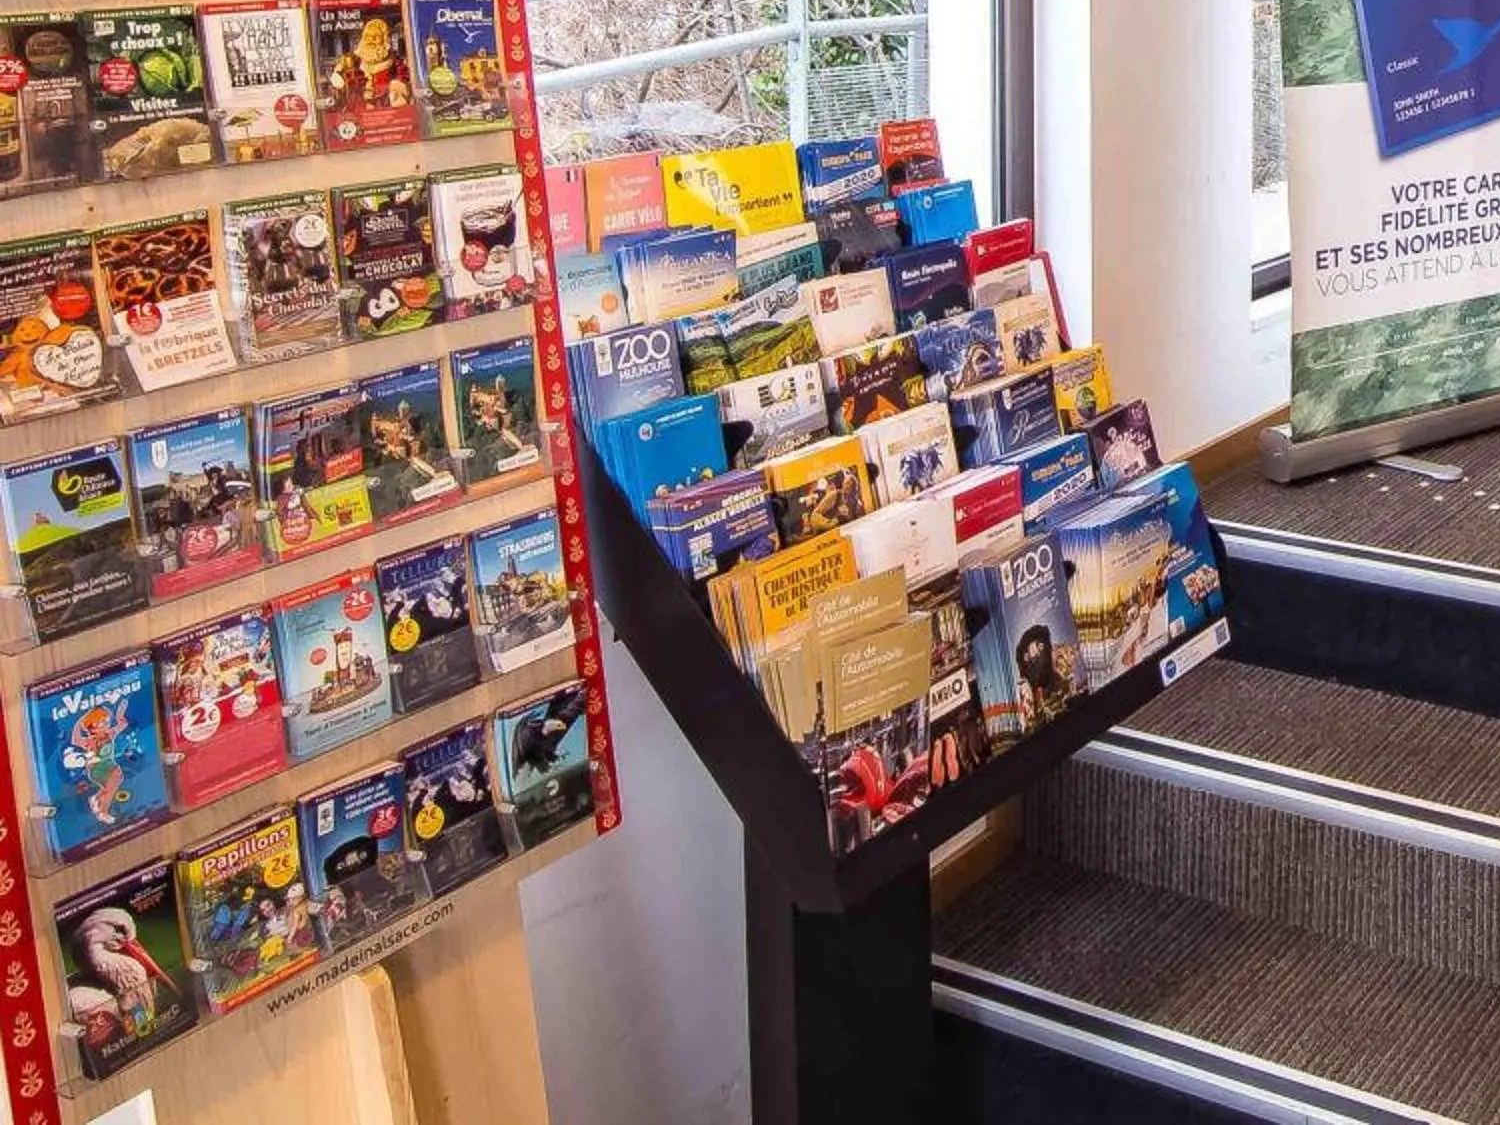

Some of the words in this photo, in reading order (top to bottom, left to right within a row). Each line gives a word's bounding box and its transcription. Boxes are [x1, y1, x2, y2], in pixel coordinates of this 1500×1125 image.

[127, 21, 162, 36] Trop
[1387, 56, 1420, 74] Classic
[695, 167, 720, 189] Ta
[709, 181, 741, 203] vie
[1391, 178, 1457, 205] VOTRE
[1381, 197, 1469, 234] FIDÉLITÉ
[1315, 247, 1341, 271] ET
[1350, 242, 1390, 266] SES
[1316, 270, 1378, 298] VOUS
[1384, 253, 1463, 284] ATTEND
[154, 340, 225, 368] BRETZELS
[613, 329, 671, 370] ZOO
[763, 568, 808, 596] CHEMIN
[820, 554, 844, 572] FER
[1012, 544, 1054, 588] ZOO
[769, 570, 841, 609] TOURISTIQUE
[202, 826, 290, 875] Papillons
[266, 901, 455, 1015] www.madeinalsace.com
